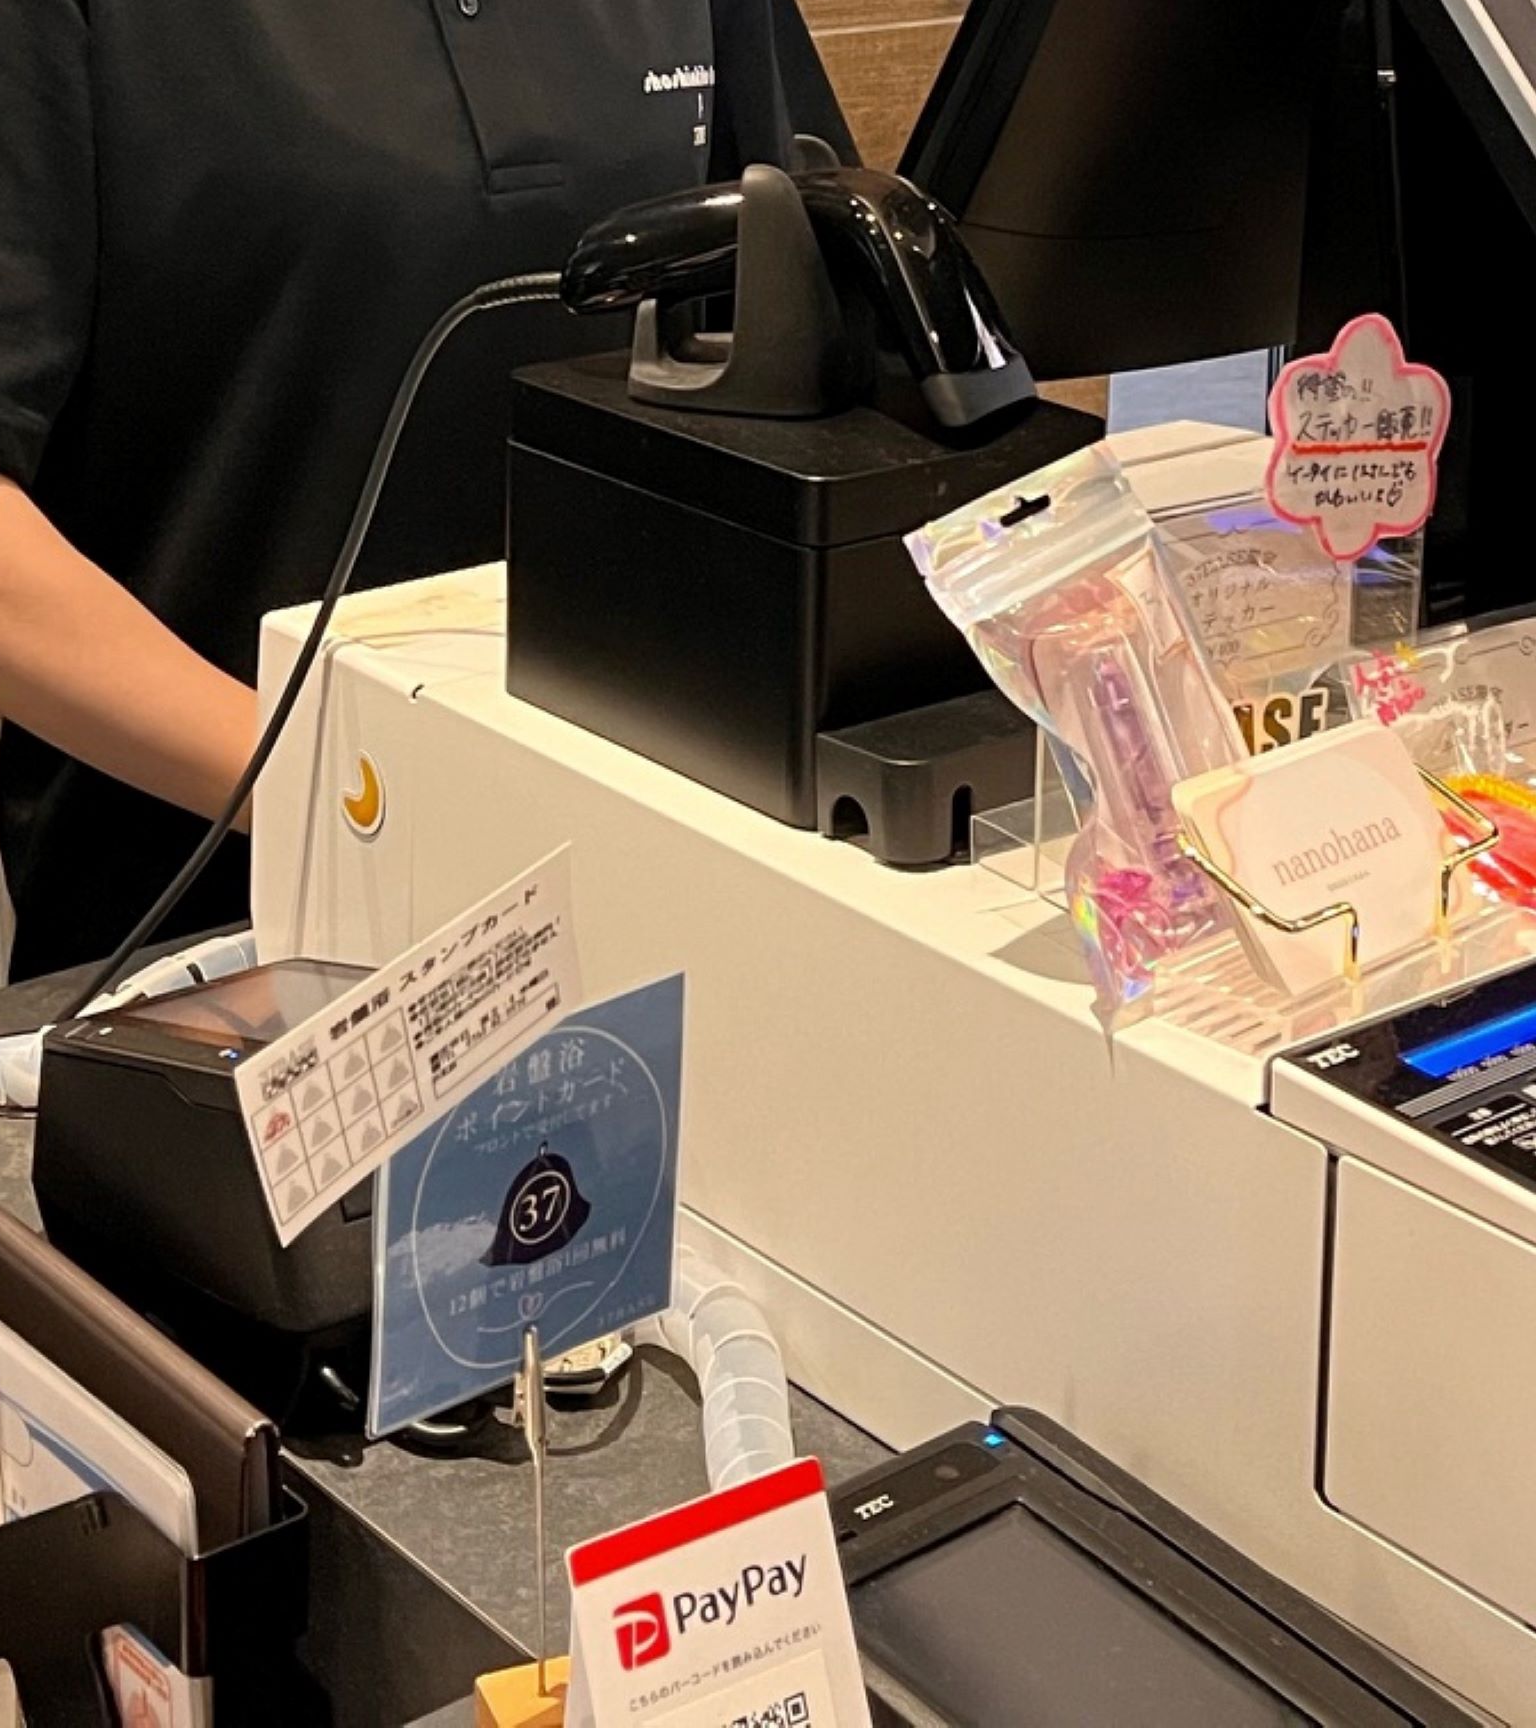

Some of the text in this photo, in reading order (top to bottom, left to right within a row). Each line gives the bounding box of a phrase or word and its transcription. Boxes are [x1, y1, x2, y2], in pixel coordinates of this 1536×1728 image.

[1272, 815, 1402, 887] nanohana
[1307, 1042, 1361, 1070] TEC
[519, 1185, 561, 1232] 37
[854, 1493, 894, 1520] TEC
[672, 1554, 807, 1634] PayPay
[628, 1623, 823, 1713] こちらのバーコードを読み込んでください
